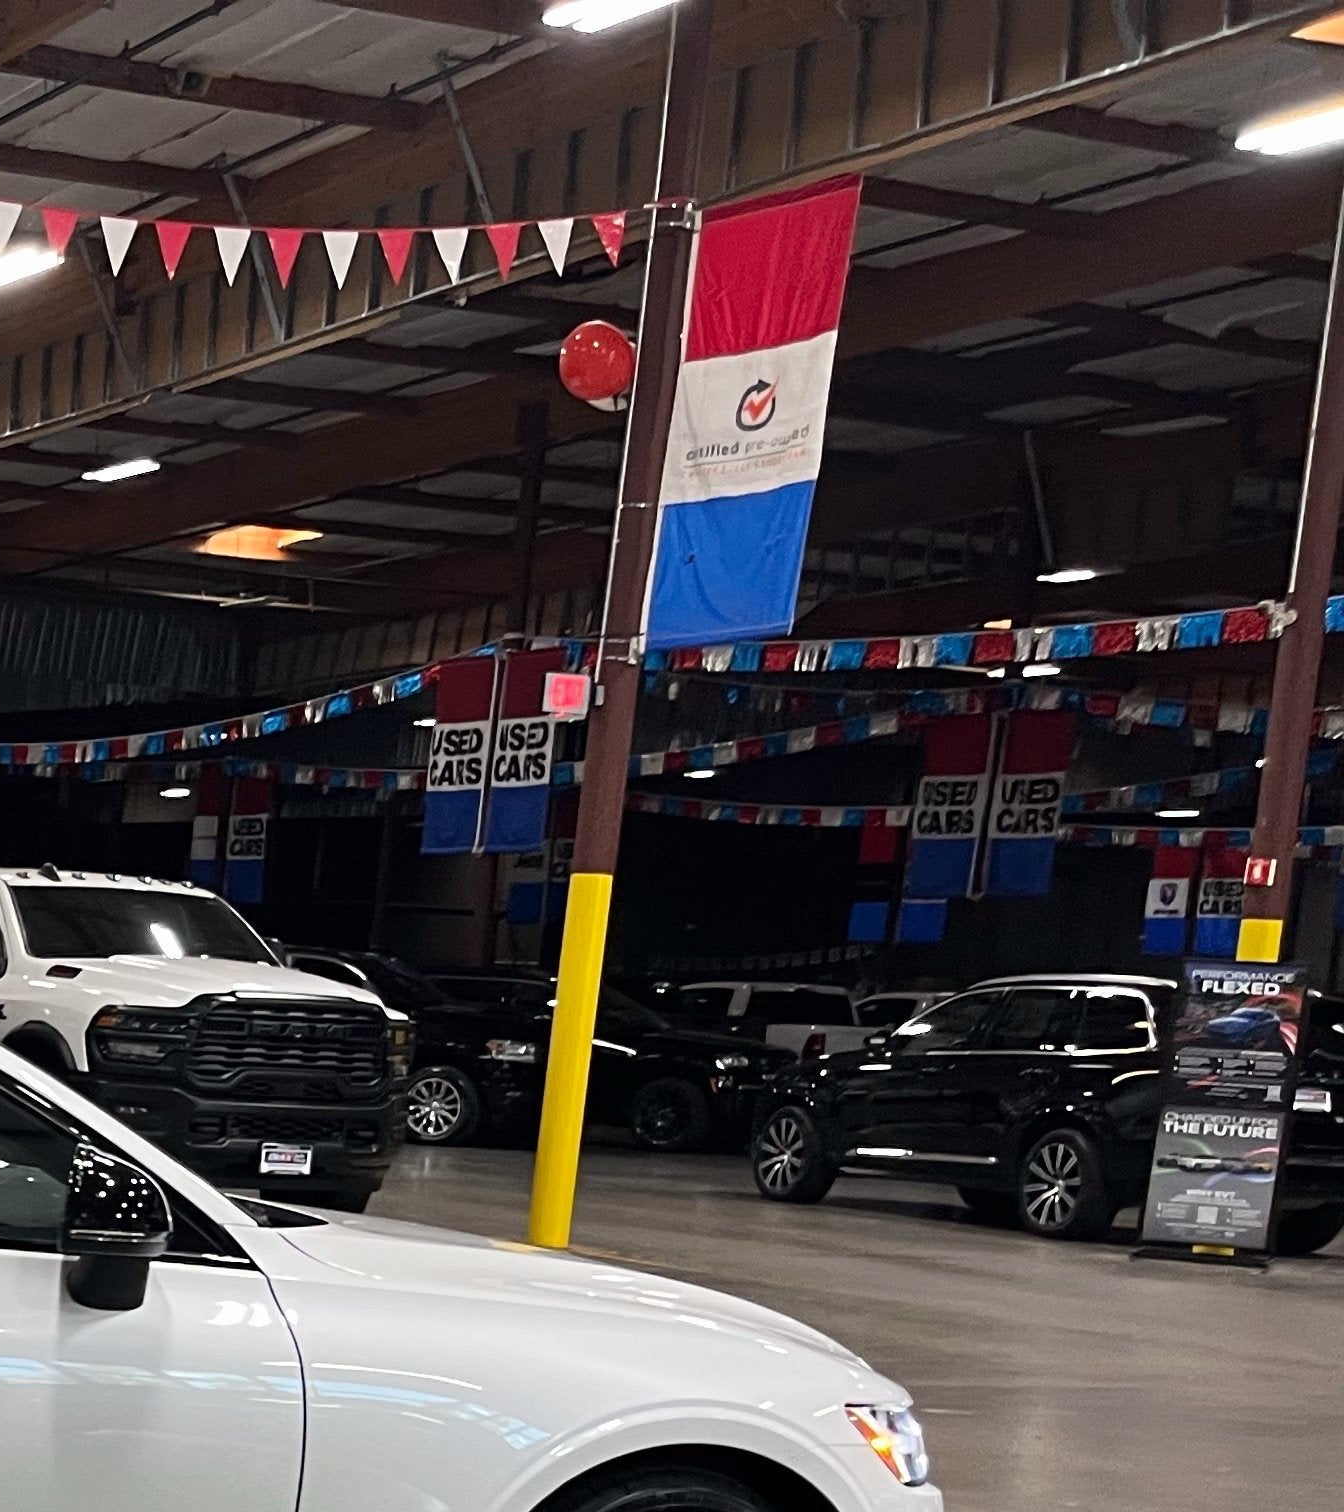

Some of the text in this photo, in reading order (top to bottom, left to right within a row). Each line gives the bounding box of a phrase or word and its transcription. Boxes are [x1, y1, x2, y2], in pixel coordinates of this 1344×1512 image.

[432, 728, 484, 757] USED
[499, 721, 550, 751] USED
[429, 757, 482, 786] CARS
[494, 752, 547, 782] CARS
[922, 780, 978, 807] USED
[1001, 778, 1060, 805] USED
[916, 808, 974, 835] CARS
[996, 807, 1057, 834] CARS
[1193, 969, 1295, 984] PERFORMANCE
[1202, 979, 1281, 997] FLEXED
[1163, 1120, 1278, 1140] THE FUTURE
